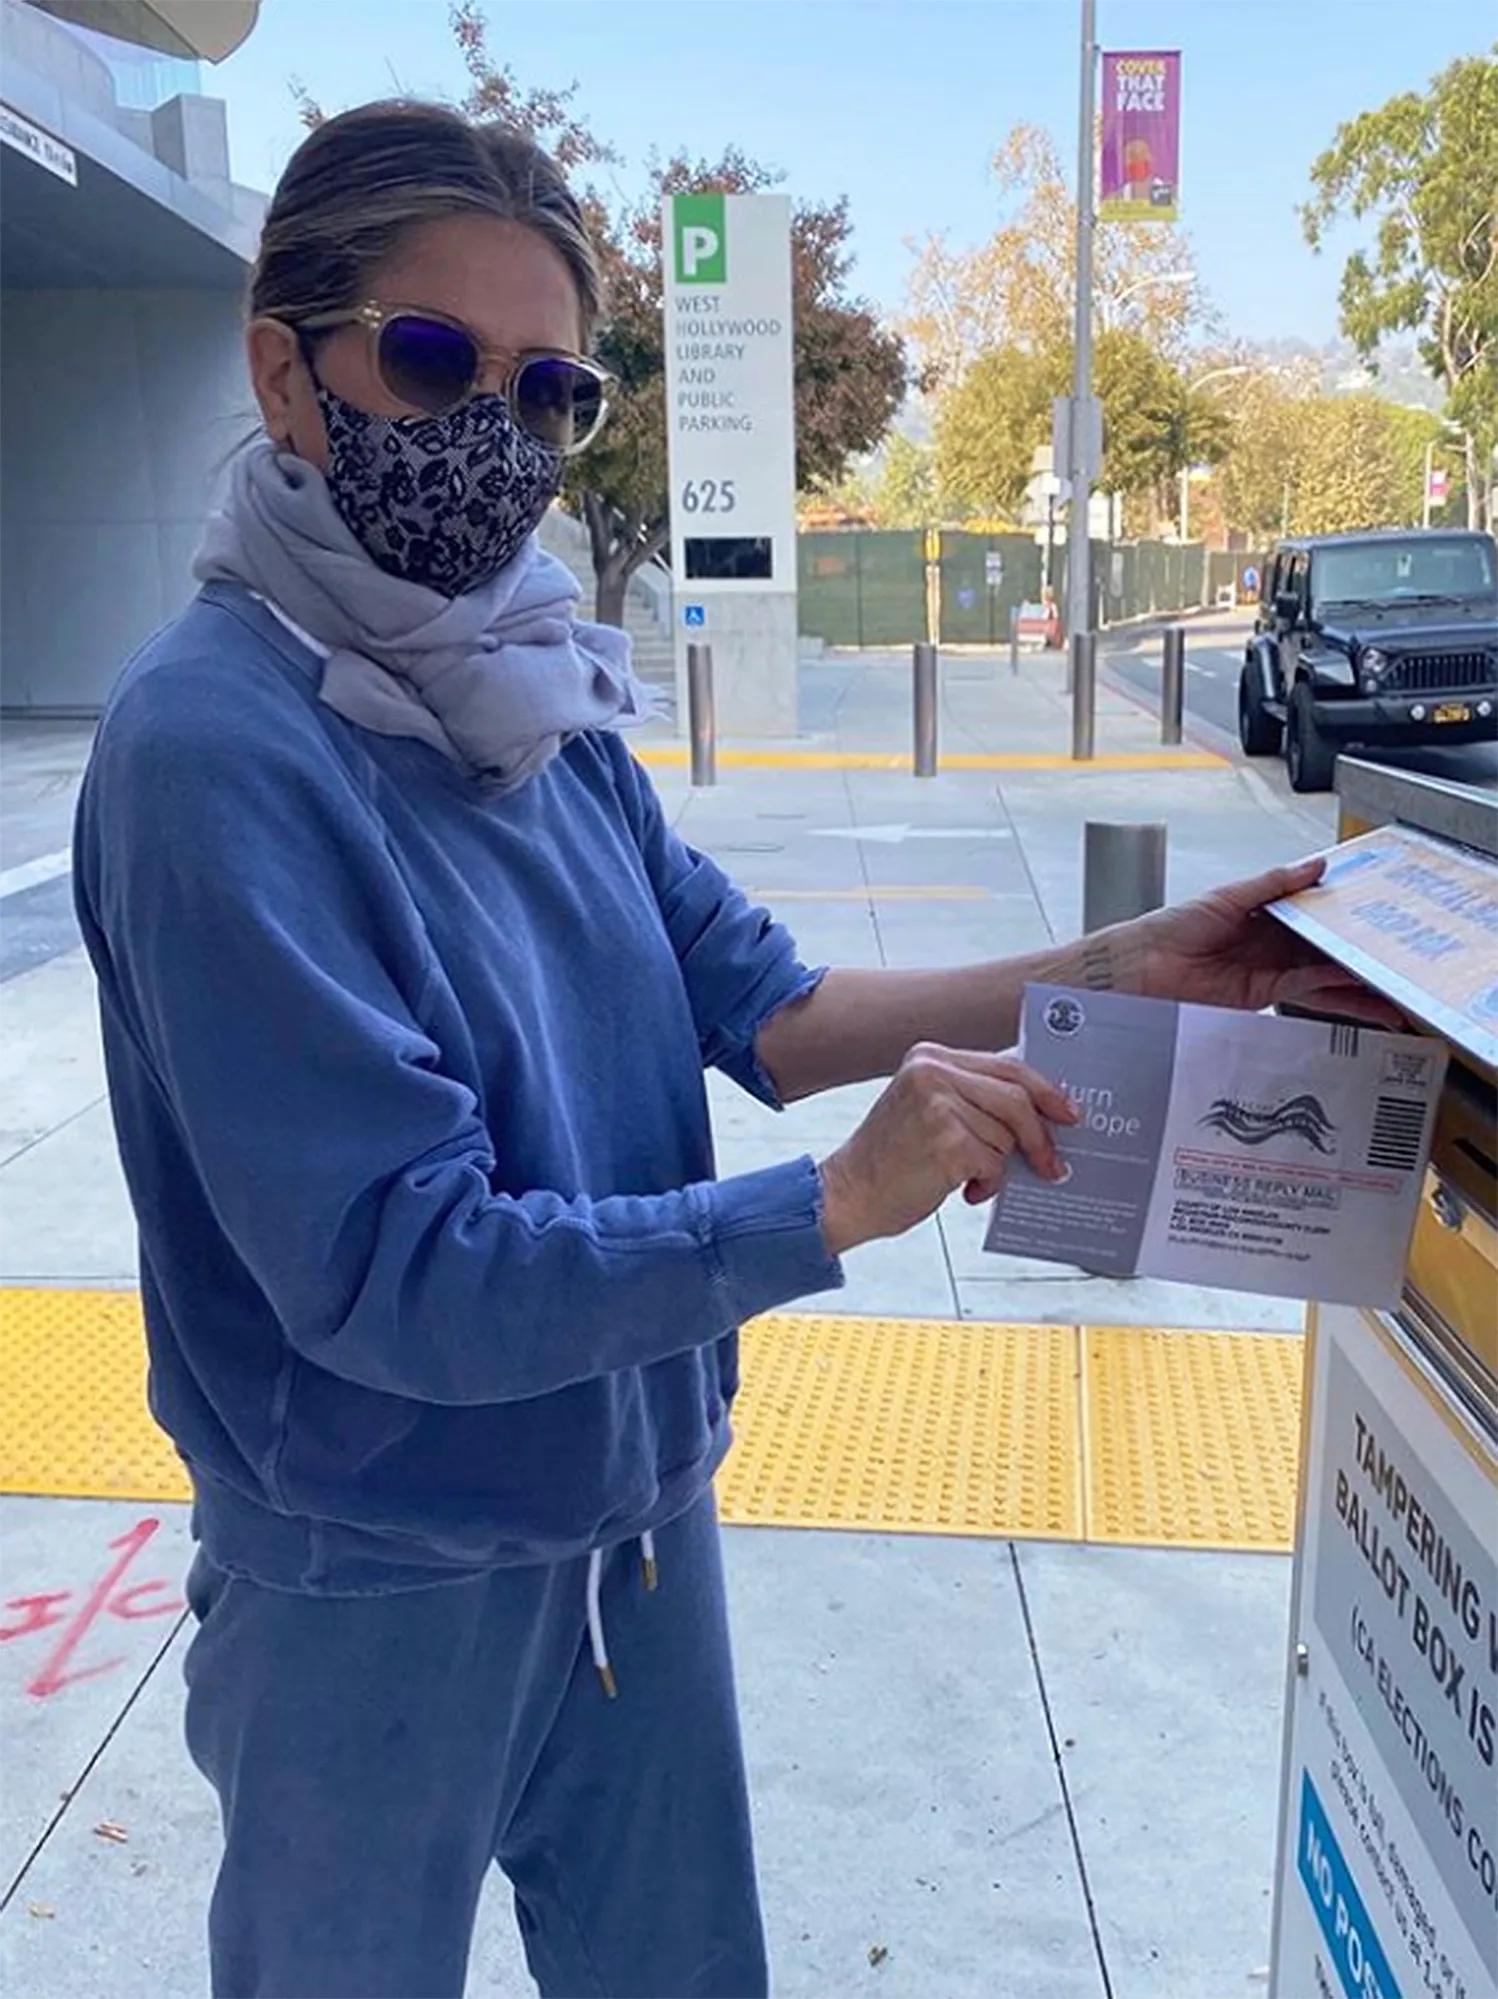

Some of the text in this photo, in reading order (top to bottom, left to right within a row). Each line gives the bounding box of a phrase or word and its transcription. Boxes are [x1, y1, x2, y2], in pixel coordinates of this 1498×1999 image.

[1116, 74, 1166, 92] THAT
[1116, 92, 1166, 112] FACE
[682, 225, 719, 276] P
[675, 295, 721, 314] WEST
[676, 319, 782, 337] HOLLYWOOD
[676, 342, 745, 361] LIBRARY
[678, 367, 716, 384] AND
[677, 391, 734, 409] PUBLIC
[678, 414, 753, 432] PARKING
[682, 479, 735, 514] 625
[1059, 1078, 1113, 1108] turn
[1084, 1106, 1141, 1138] lope
[1355, 1411, 1481, 1640] TAMPERING
[1336, 1468, 1496, 1766] BALLOT BOX IS
[1352, 1605, 1498, 1913] (CA ELECTIONS CO
[1307, 1819, 1334, 1909] NO
